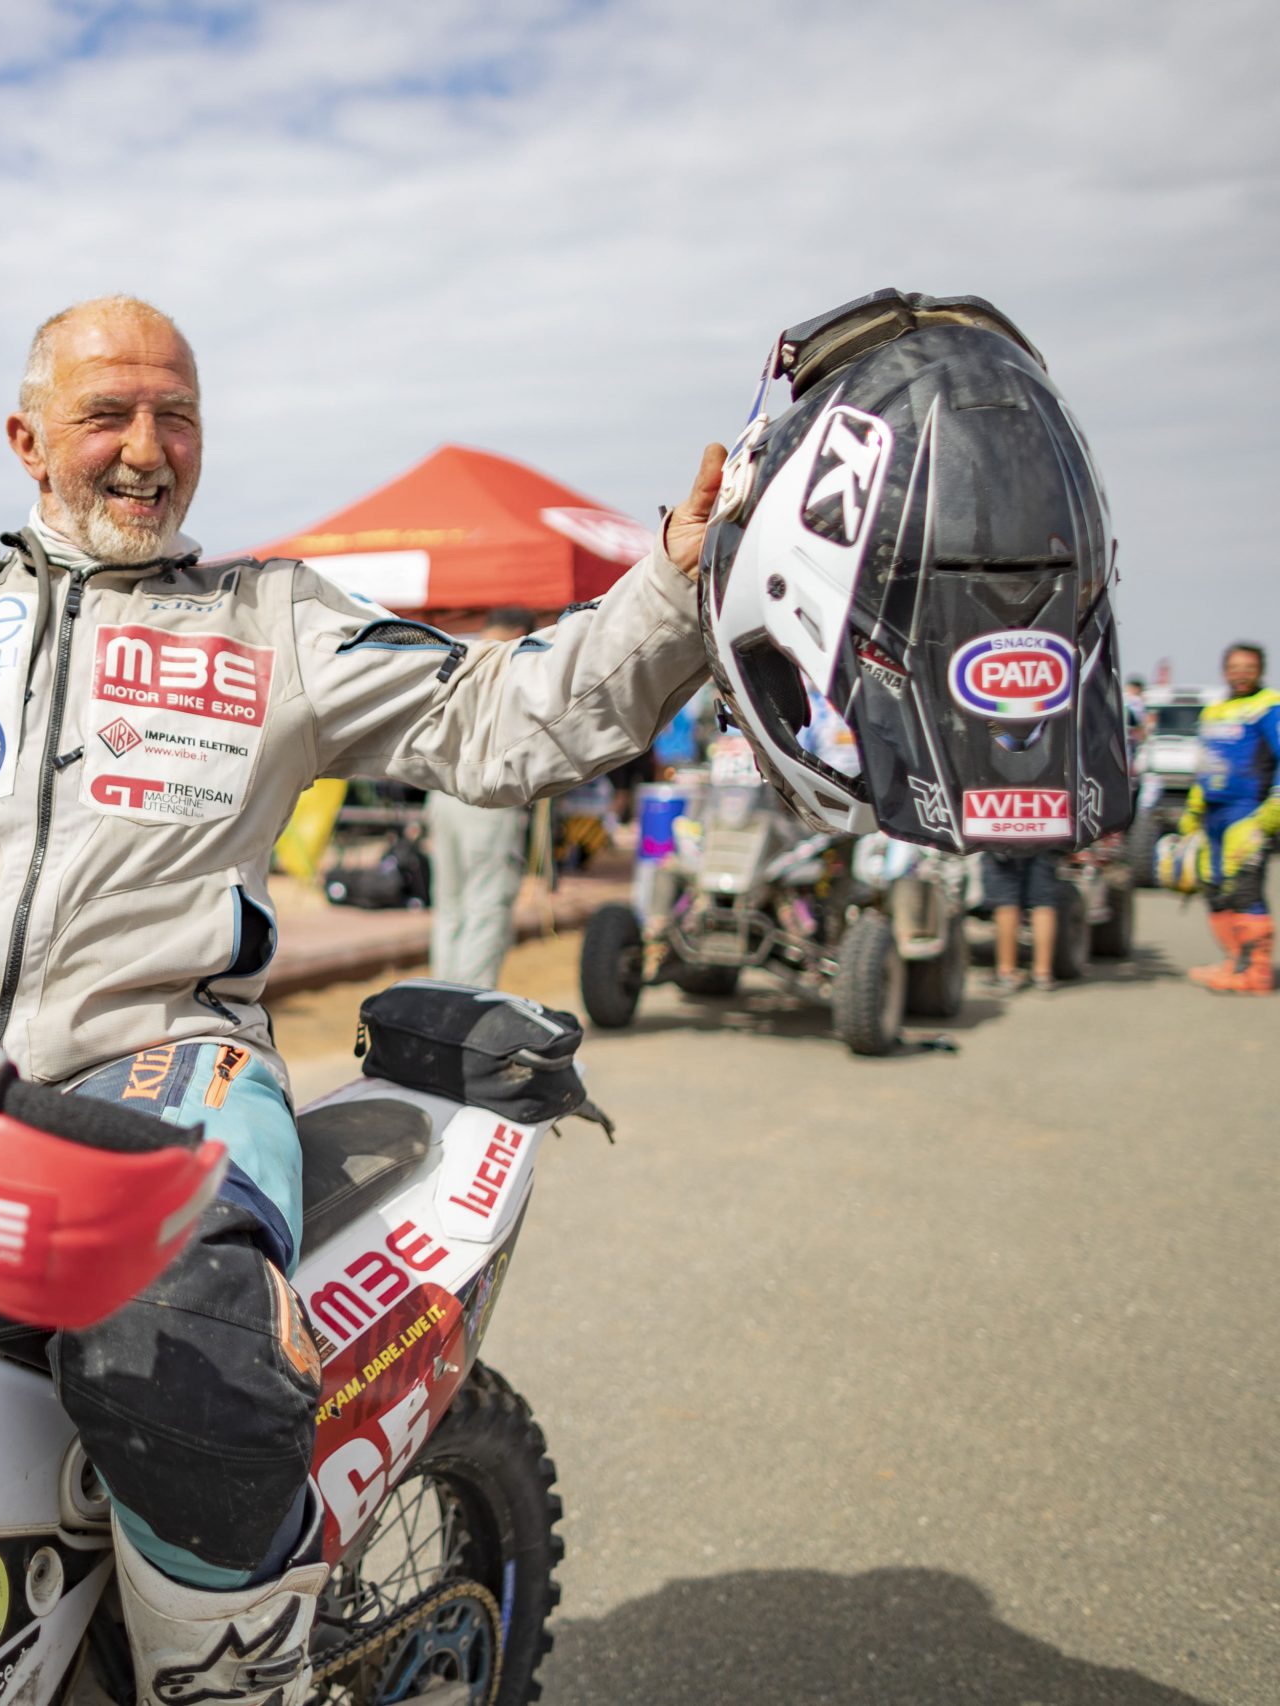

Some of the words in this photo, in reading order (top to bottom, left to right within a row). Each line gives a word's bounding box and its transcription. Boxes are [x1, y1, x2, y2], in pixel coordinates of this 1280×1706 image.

[993, 635, 1044, 651] SNACK
[981, 660, 1055, 689] PATA
[103, 683, 160, 704] MOTOR
[166, 693, 205, 710] BIKE
[211, 702, 256, 719] EXPO
[144, 744, 208, 762] www.vibe.it
[145, 729, 196, 748] IMPIANTI
[199, 739, 249, 757] ELETTRICI
[90, 773, 165, 809] GT
[144, 791, 204, 810] MACCHINE
[166, 781, 234, 805] TREVISAN
[143, 800, 195, 819] UTENSILI
[968, 792, 1067, 818] WHY
[991, 821, 1048, 833] SPORT
[314, 1376, 367, 1426] REAM.
[362, 1342, 405, 1384] DARE.
[399, 1315, 432, 1349] LIVE
[426, 1303, 447, 1325] IT.
[318, 1380, 432, 1548] 65
